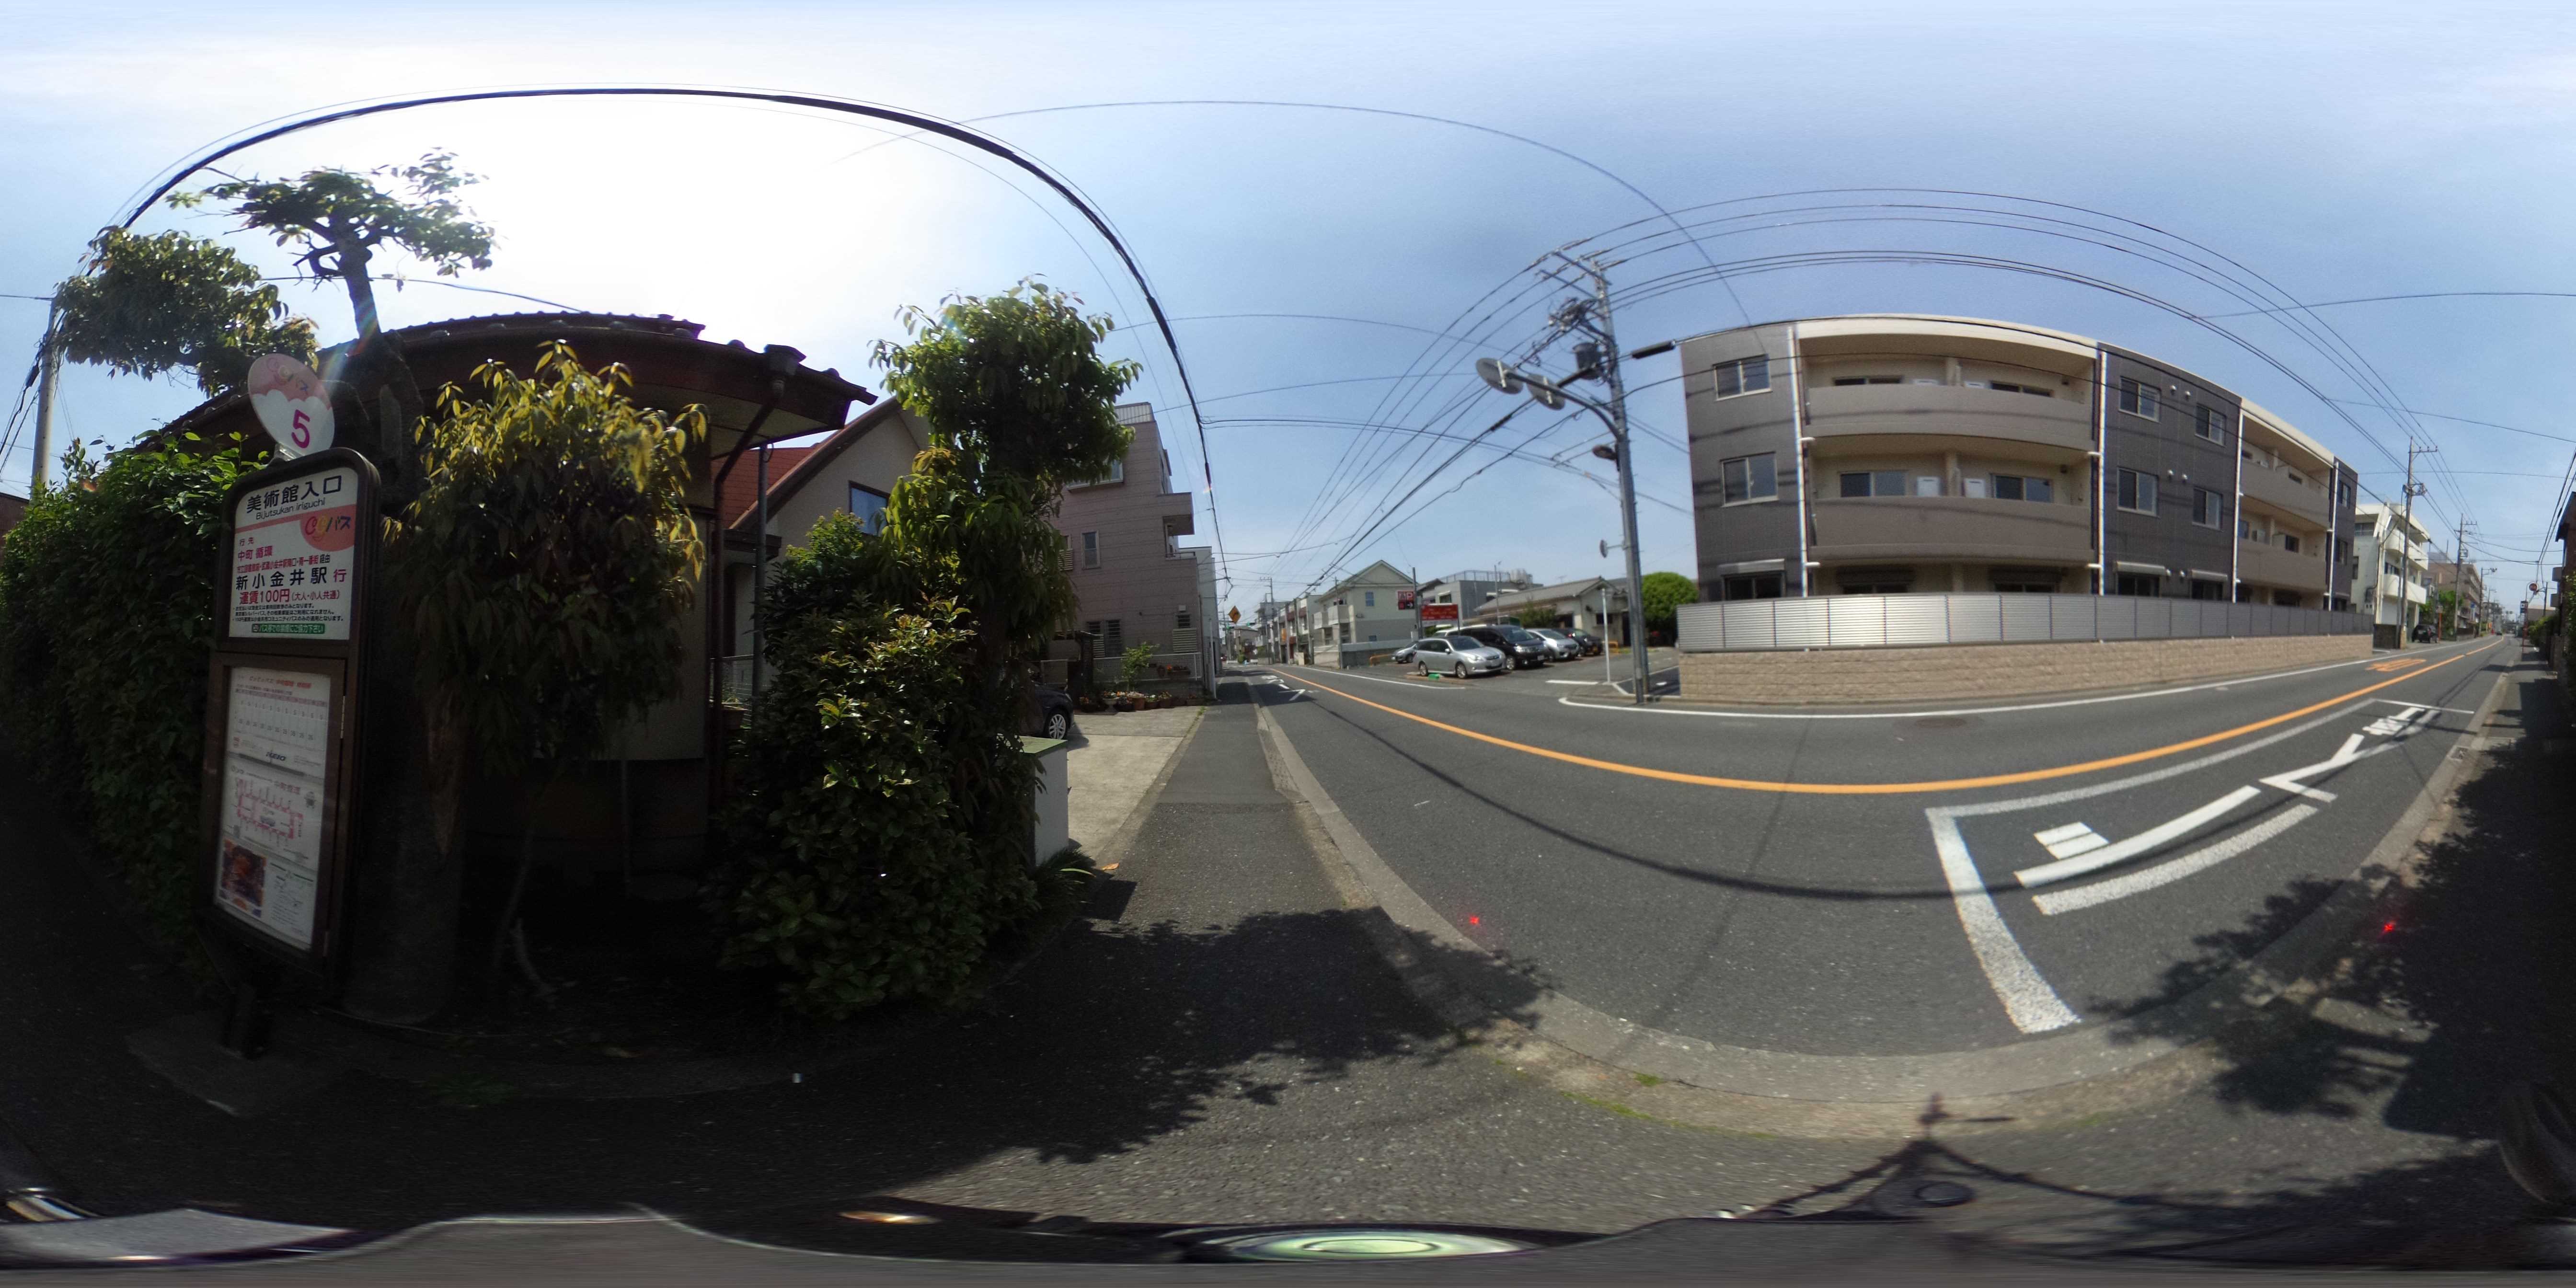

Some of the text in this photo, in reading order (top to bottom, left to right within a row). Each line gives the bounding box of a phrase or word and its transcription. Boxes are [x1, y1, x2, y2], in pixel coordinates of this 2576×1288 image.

[291, 409, 310, 448] 5
[246, 475, 342, 514] 美術館入口
[255, 497, 325, 520] Bijutsukan iriguchi
[238, 549, 253, 562] 中町
[235, 567, 346, 591] 新小金井駅 行
[239, 588, 290, 605] 運賃100円
[265, 751, 287, 761] KEIO
